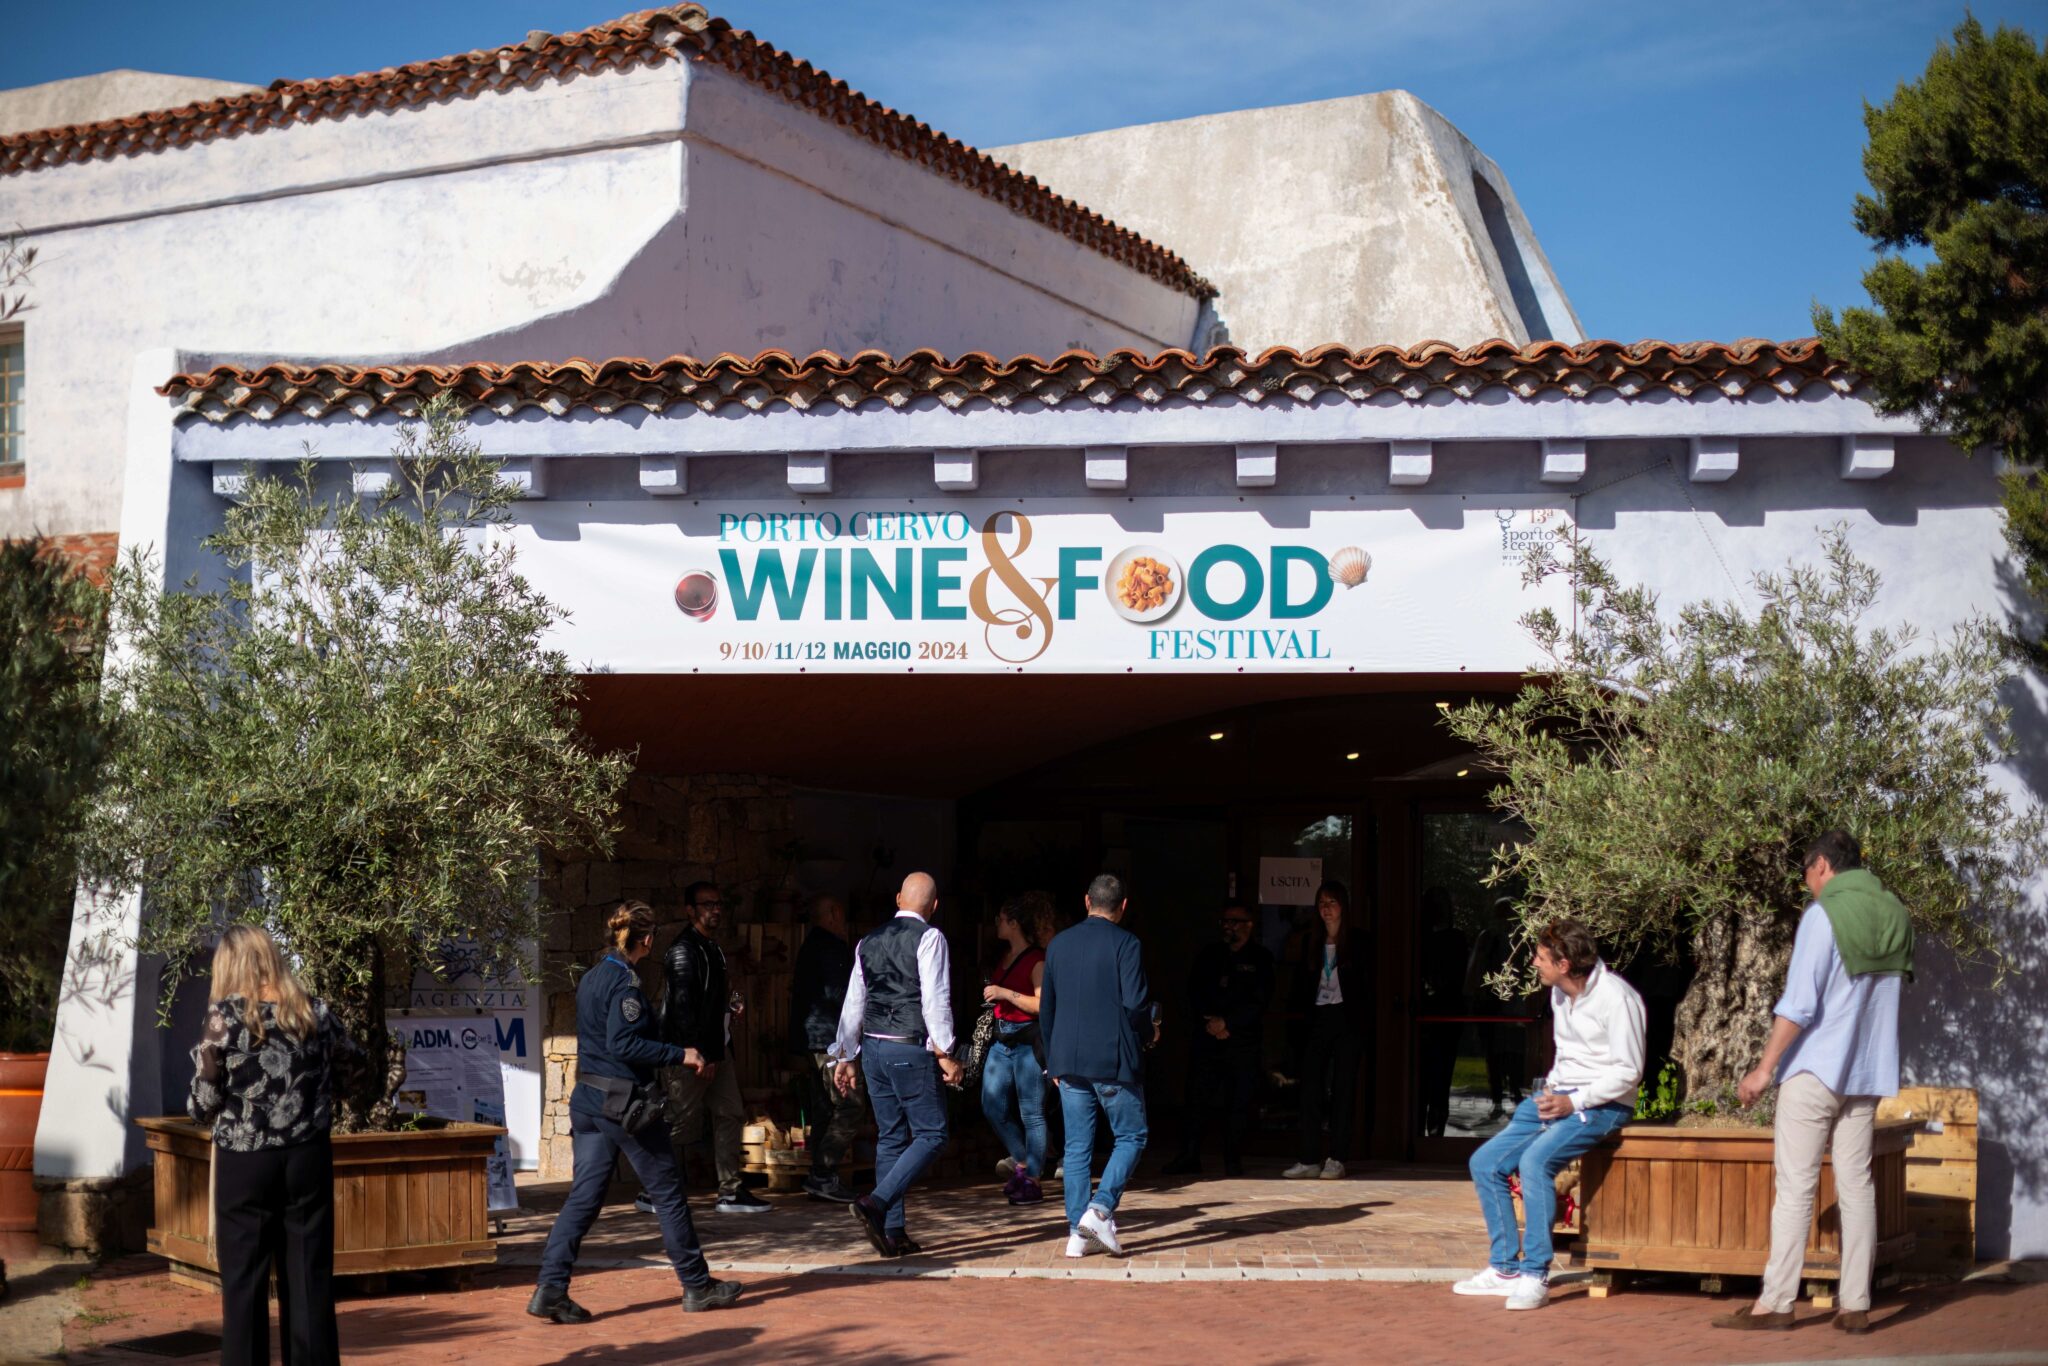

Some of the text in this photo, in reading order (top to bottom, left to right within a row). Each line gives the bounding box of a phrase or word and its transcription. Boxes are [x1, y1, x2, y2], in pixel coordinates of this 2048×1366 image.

[717, 510, 970, 542] PORTO CERVO
[1509, 526, 1554, 542] porto
[717, 546, 968, 621] WINE
[968, 510, 1060, 664] &
[719, 641, 969, 661] 9/10/11/12 MAGGIO 2024
[1147, 629, 1332, 660] FESTIVAL
[1270, 875, 1311, 888] USCITA
[414, 993, 524, 1006] AGENZIA
